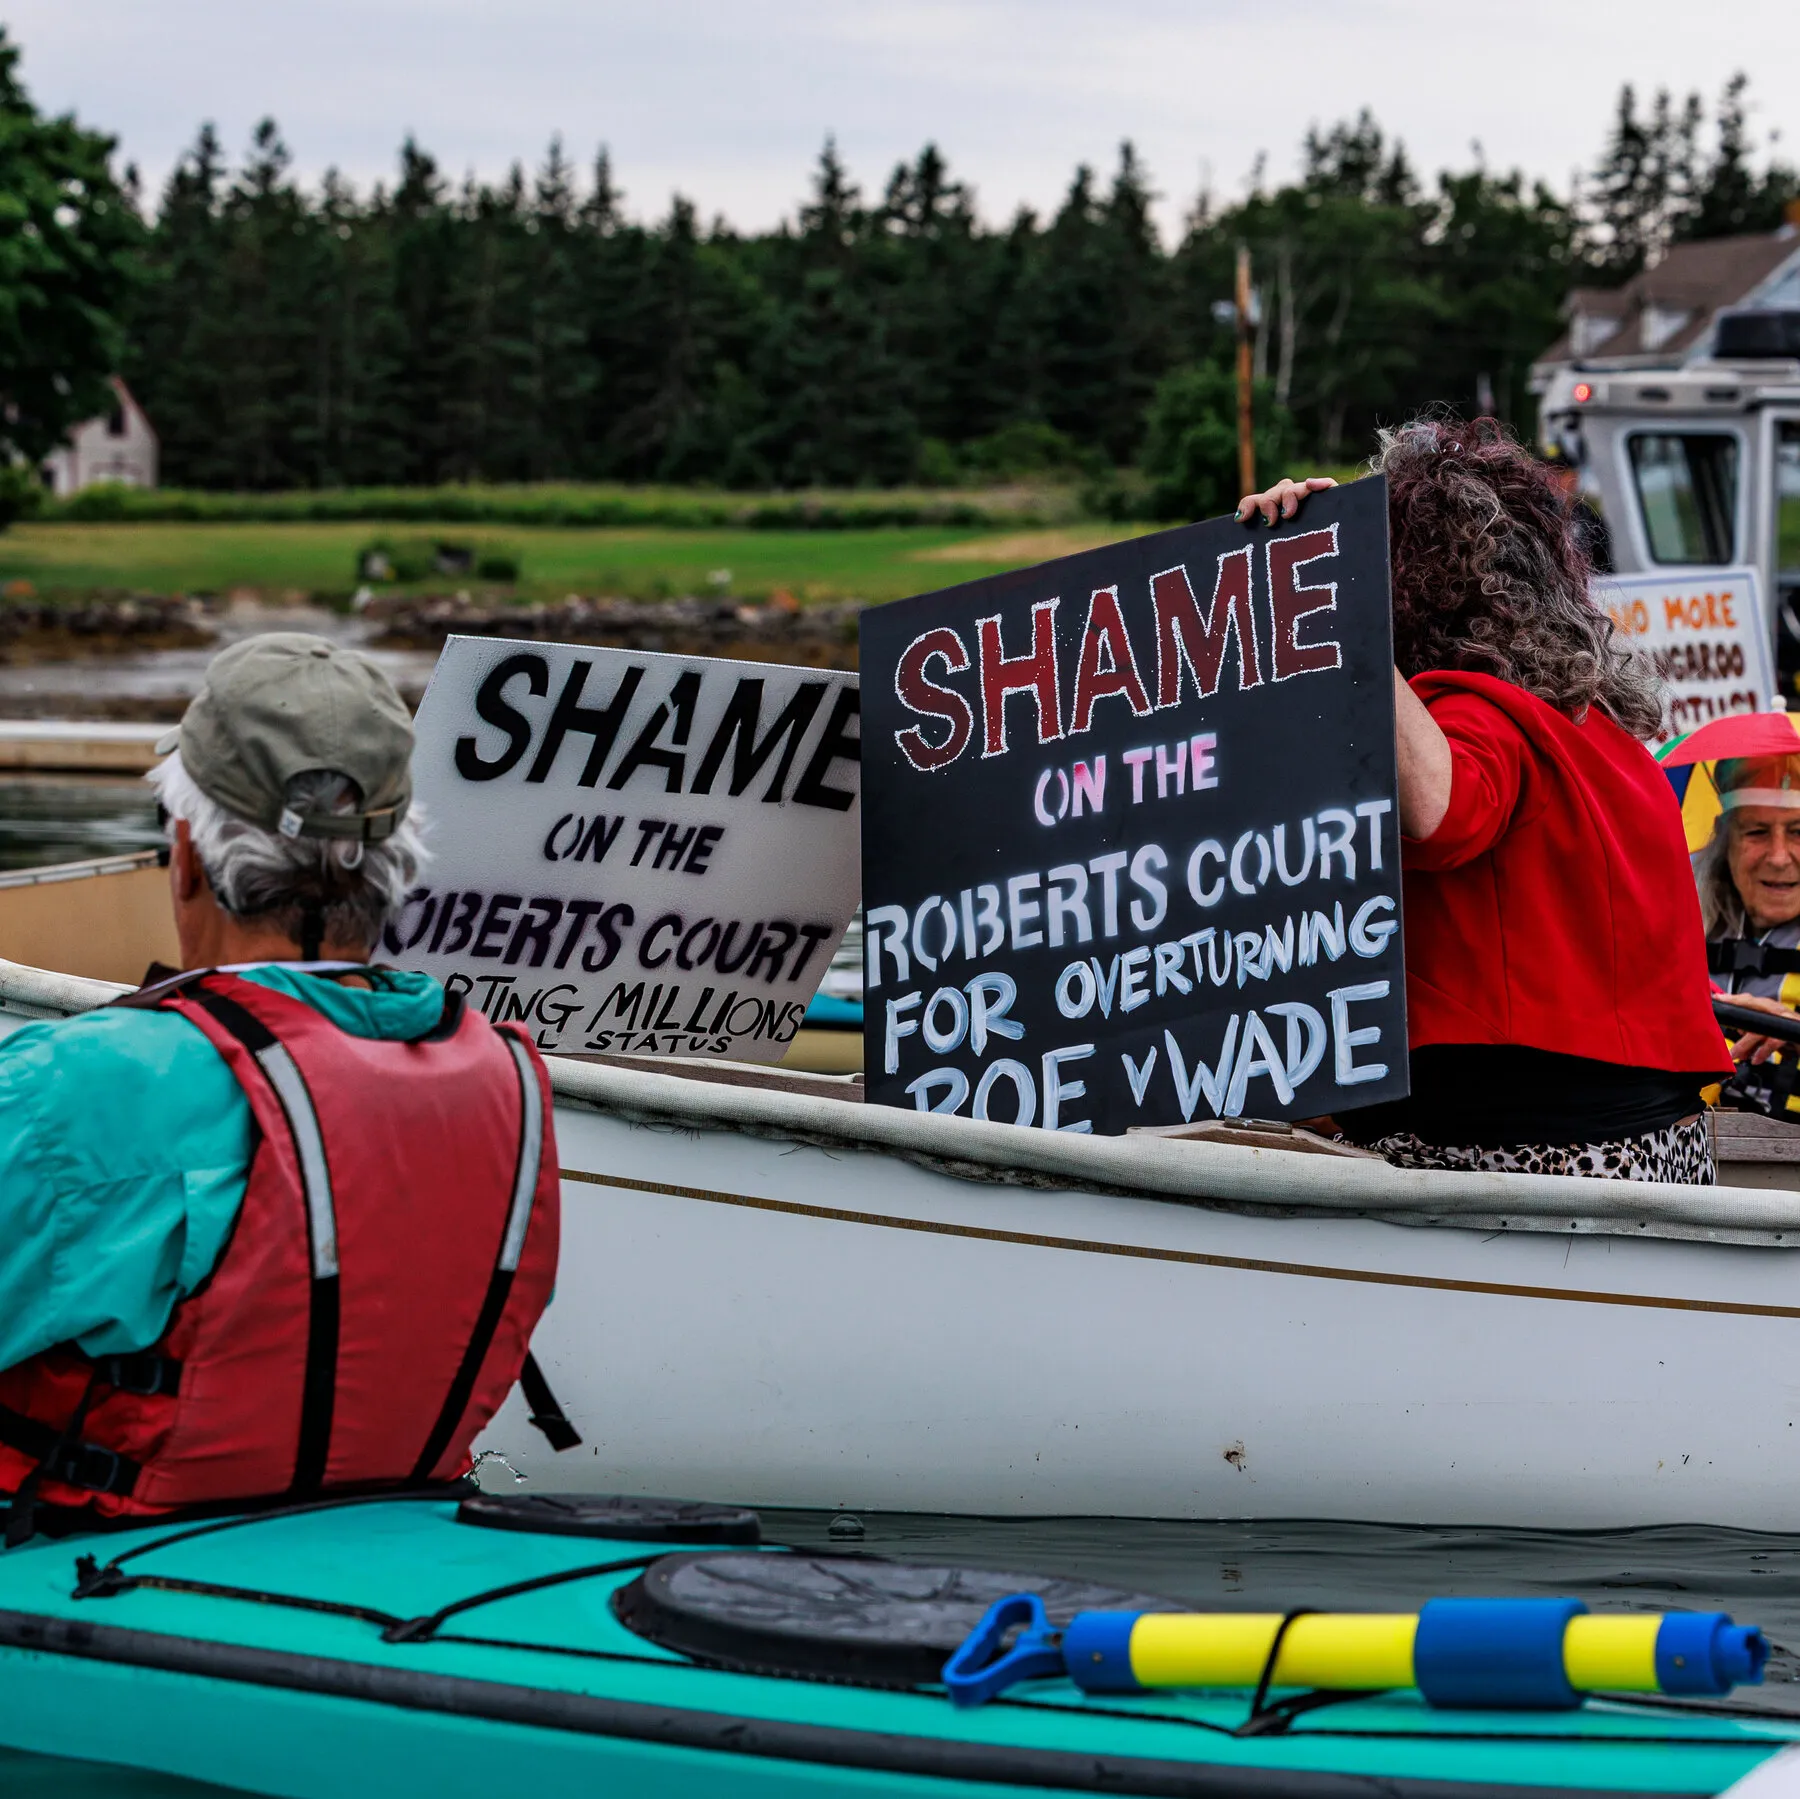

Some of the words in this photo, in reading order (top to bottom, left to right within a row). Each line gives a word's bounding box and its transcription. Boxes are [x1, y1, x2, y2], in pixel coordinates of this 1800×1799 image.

[894, 522, 1343, 773] SHAME
[1663, 592, 1738, 632] MORE
[455, 654, 861, 812] SHAME
[1034, 755, 1107, 827] ON
[1122, 732, 1219, 804] THE
[544, 813, 624, 863] ON
[630, 819, 725, 875] THE
[373, 887, 635, 973] OBERTS
[638, 914, 835, 984] COURT
[866, 842, 1169, 988] ROBERTS
[1187, 799, 1392, 907] COURT
[585, 981, 807, 1043] MILLIONS
[885, 971, 1026, 1075] FOR
[1055, 895, 1398, 1020] OVERTURNING
[584, 1029, 733, 1054] STATUS
[905, 1043, 1096, 1135] ROE
[1164, 980, 1390, 1123] WADE
